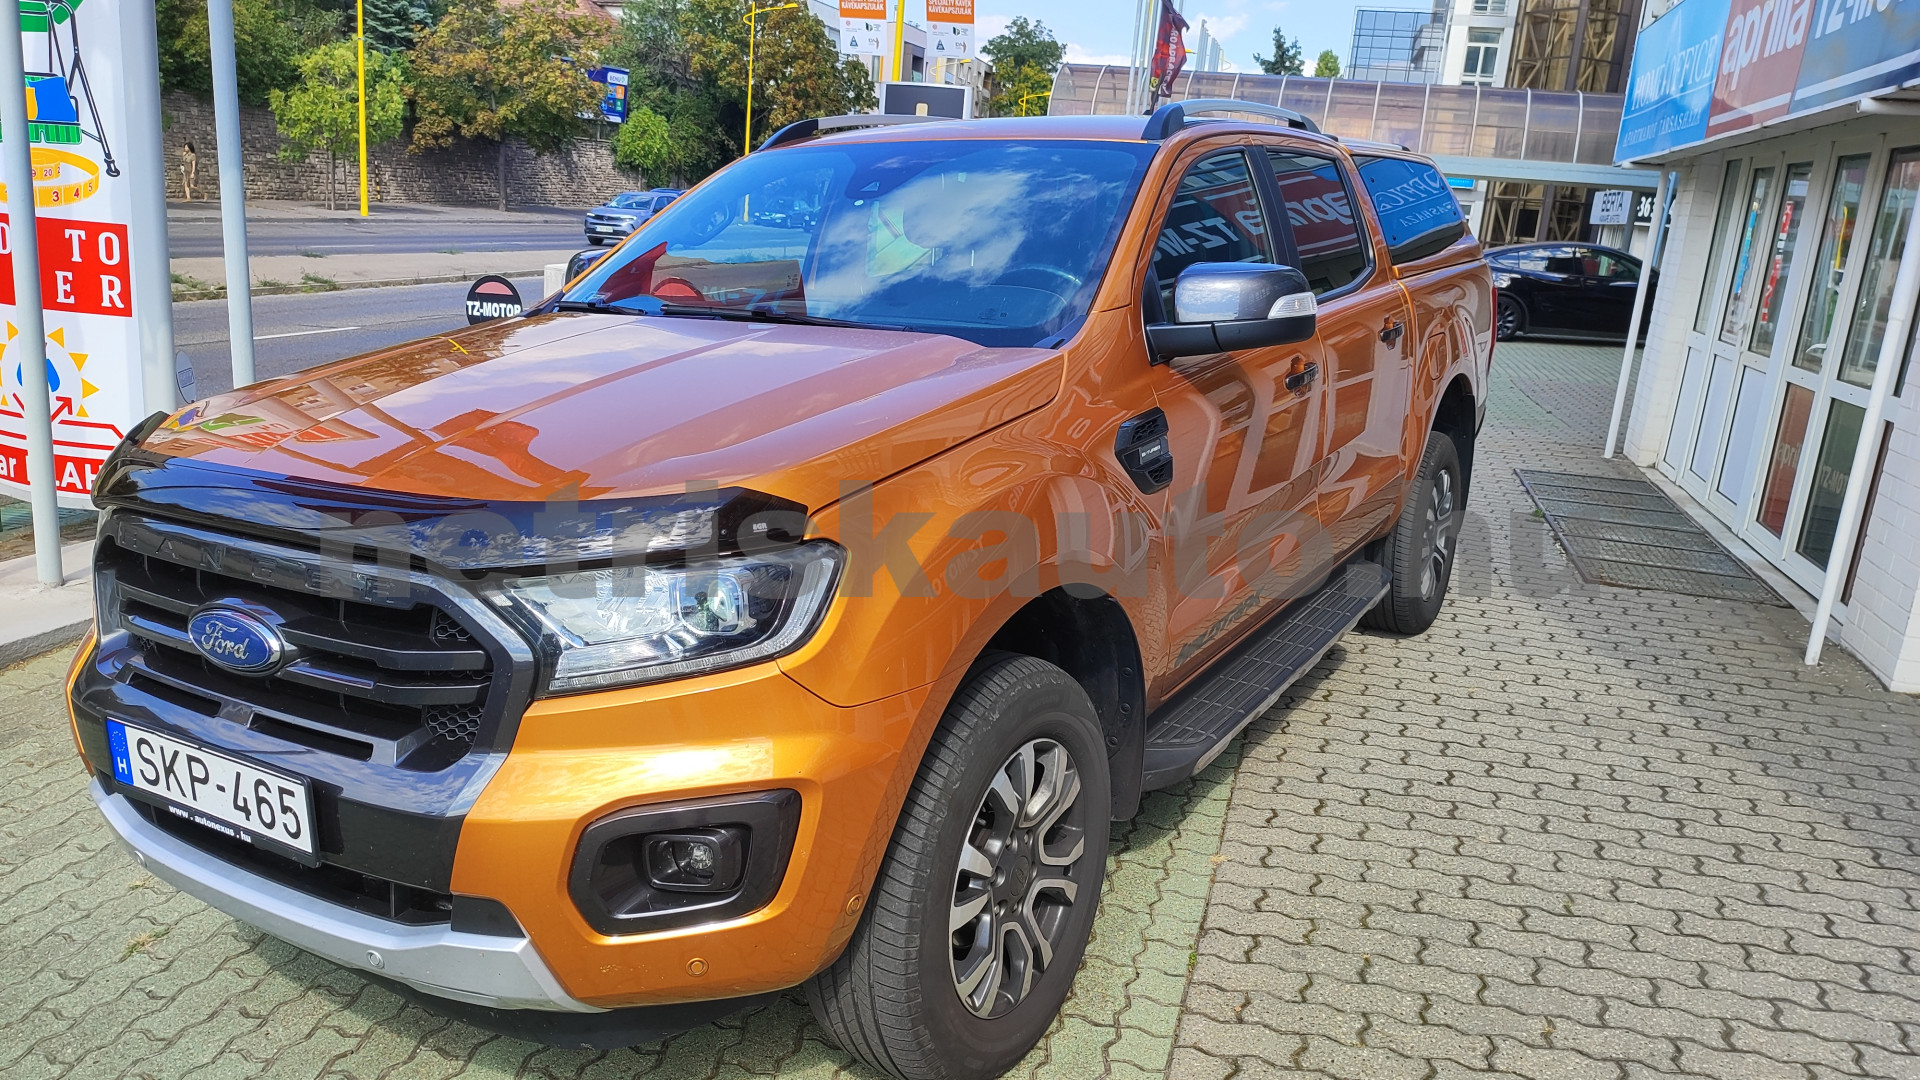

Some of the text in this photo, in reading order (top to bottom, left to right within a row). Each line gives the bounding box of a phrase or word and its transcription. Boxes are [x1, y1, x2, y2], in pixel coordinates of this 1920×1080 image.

[44, 168, 52, 176] 20
[52, 182, 93, 202] 3 4 5
[466, 300, 521, 318] TZ-MOTOR
[201, 620, 249, 660] Ford
[117, 756, 128, 775] H
[136, 736, 302, 840] SKP-465
